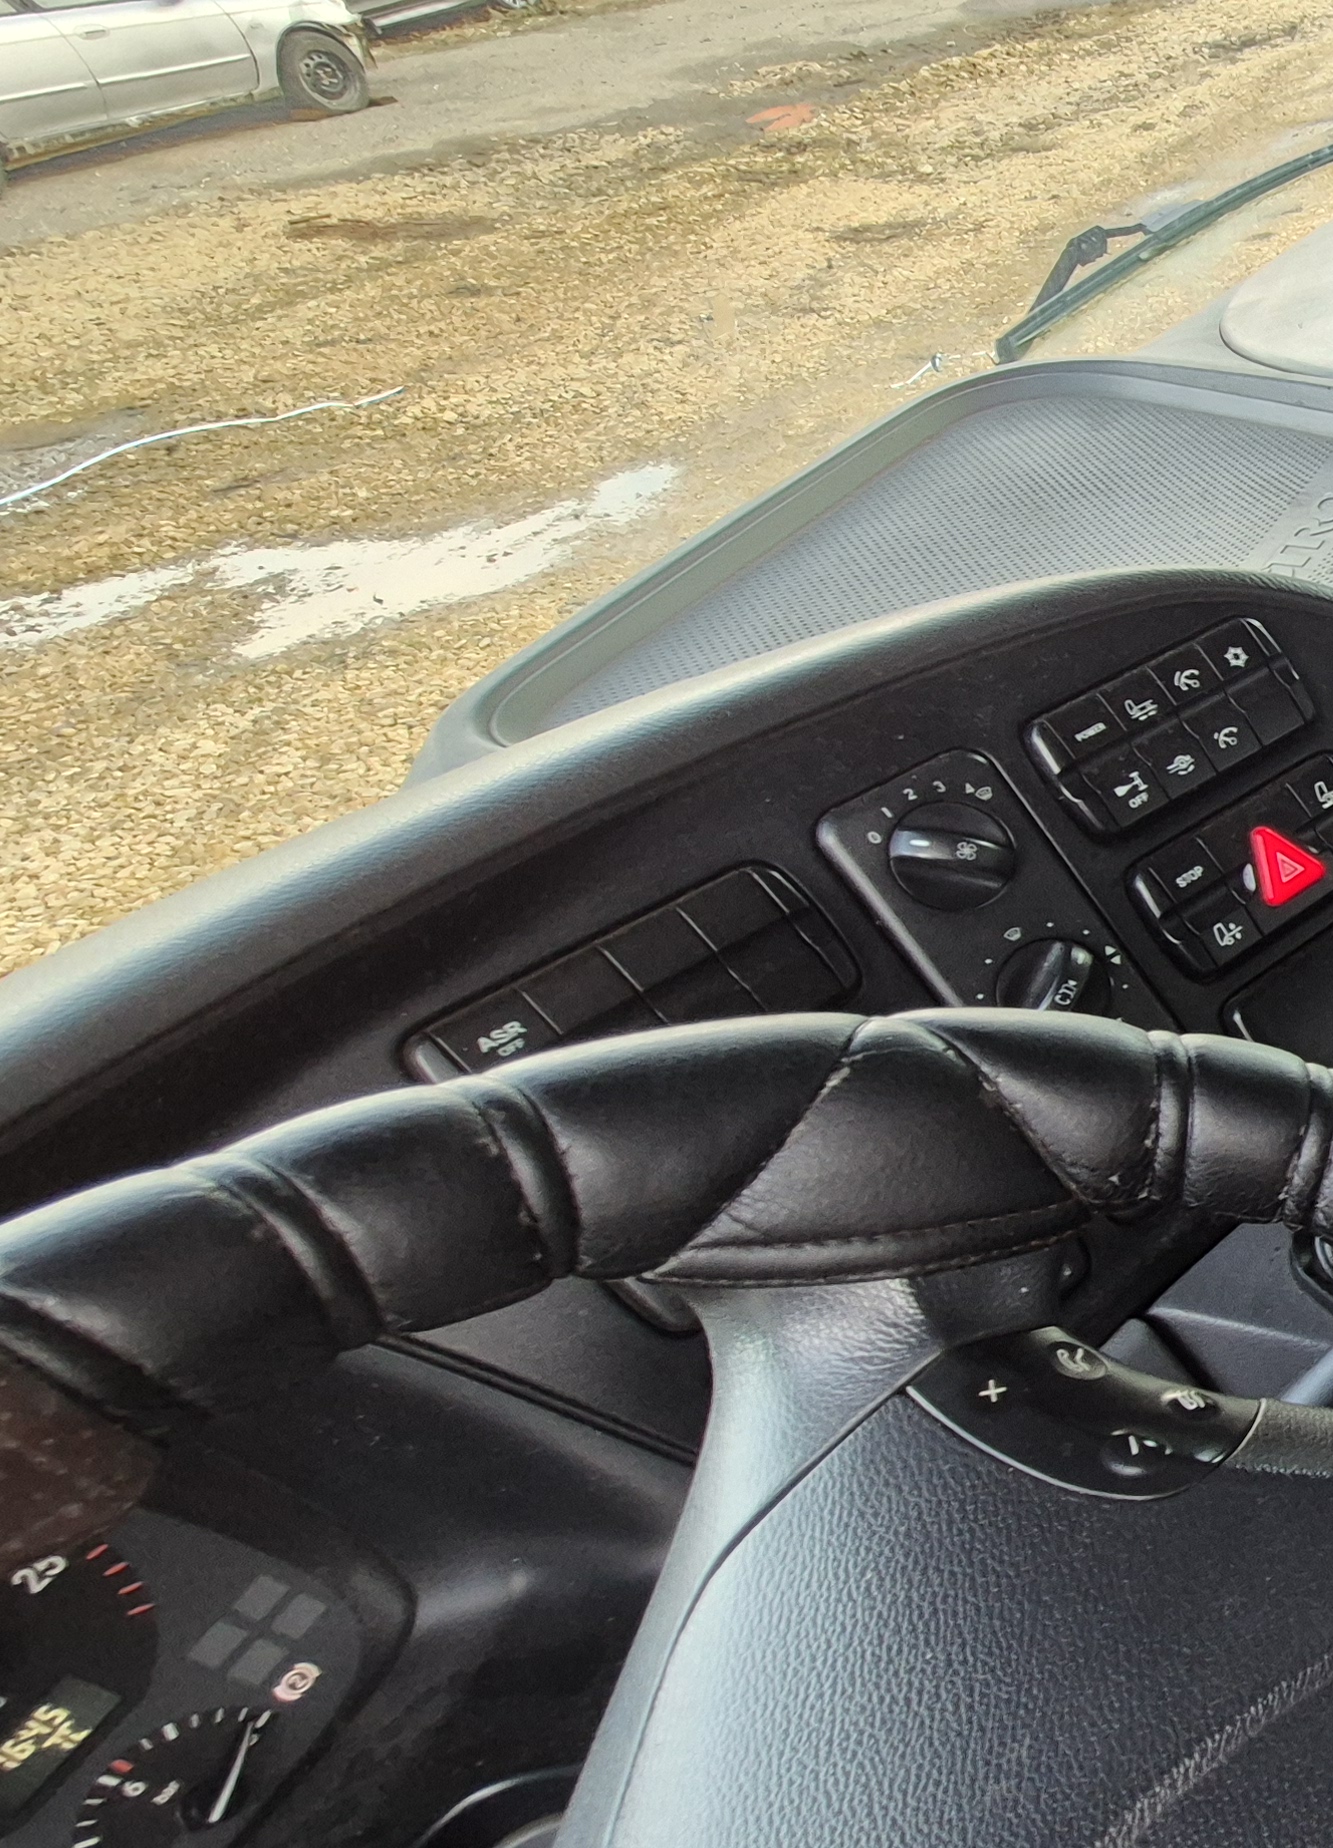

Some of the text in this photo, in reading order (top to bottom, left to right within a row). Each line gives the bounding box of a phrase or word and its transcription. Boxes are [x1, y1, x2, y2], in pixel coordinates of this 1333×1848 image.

[903, 788, 918, 801] 2
[932, 780, 947, 793] 3
[1128, 792, 1149, 809] OFF
[1175, 865, 1204, 888] STOP
[477, 1021, 528, 1053] ASR
[497, 1037, 525, 1056] OFF
[122, 1780, 148, 1798] 6
